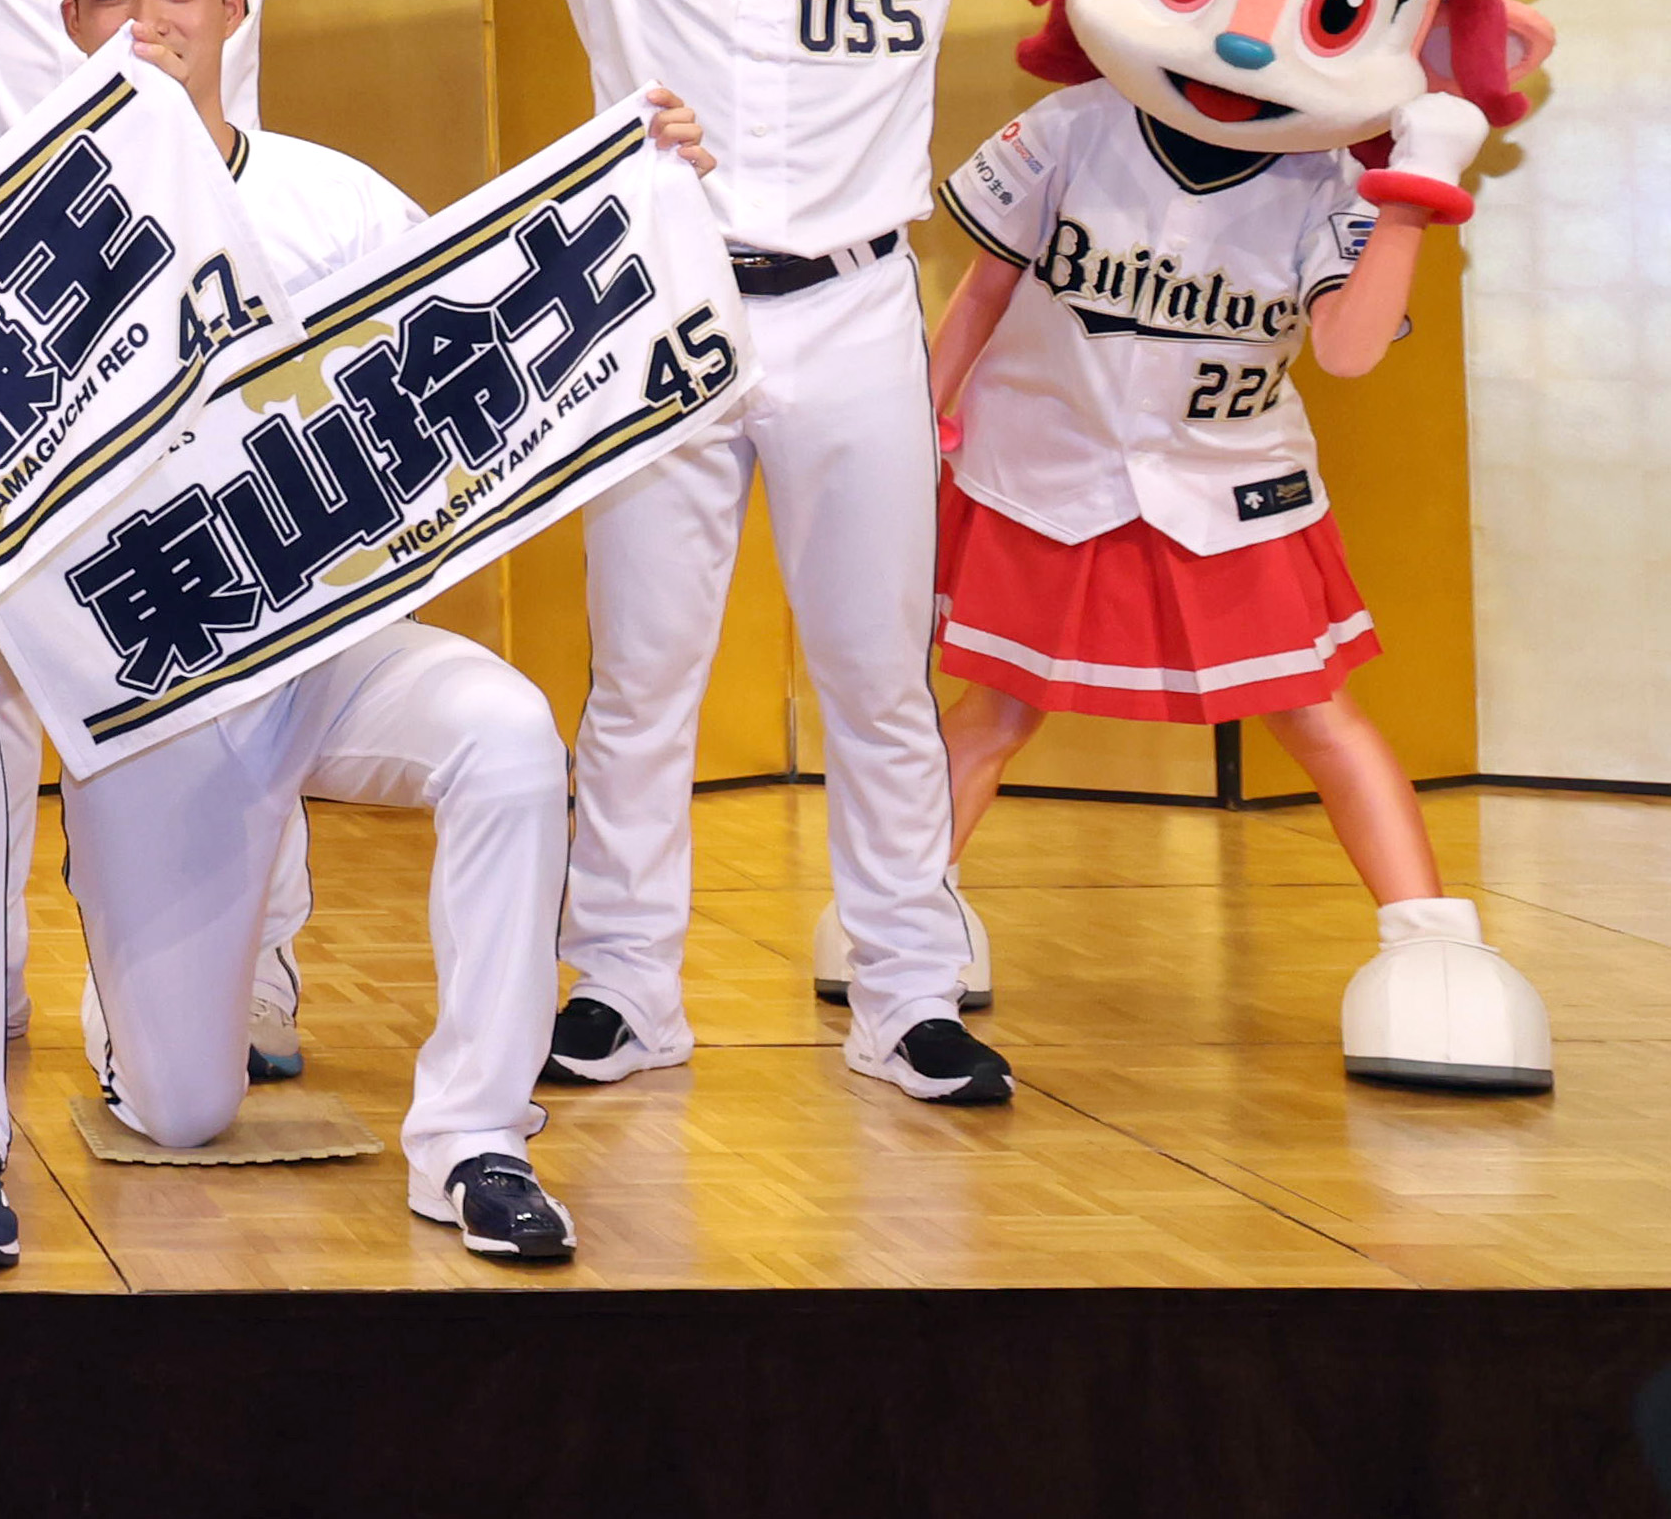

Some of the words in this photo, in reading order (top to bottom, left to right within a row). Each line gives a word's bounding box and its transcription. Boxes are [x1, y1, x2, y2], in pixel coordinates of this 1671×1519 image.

[95, 321, 152, 384] REO
[174, 248, 254, 370] 47
[638, 299, 740, 415] 45
[65, 194, 656, 699] 東山玲士
[387, 414, 555, 567] HIGASHIYAMA
[555, 350, 621, 432] REIJI
